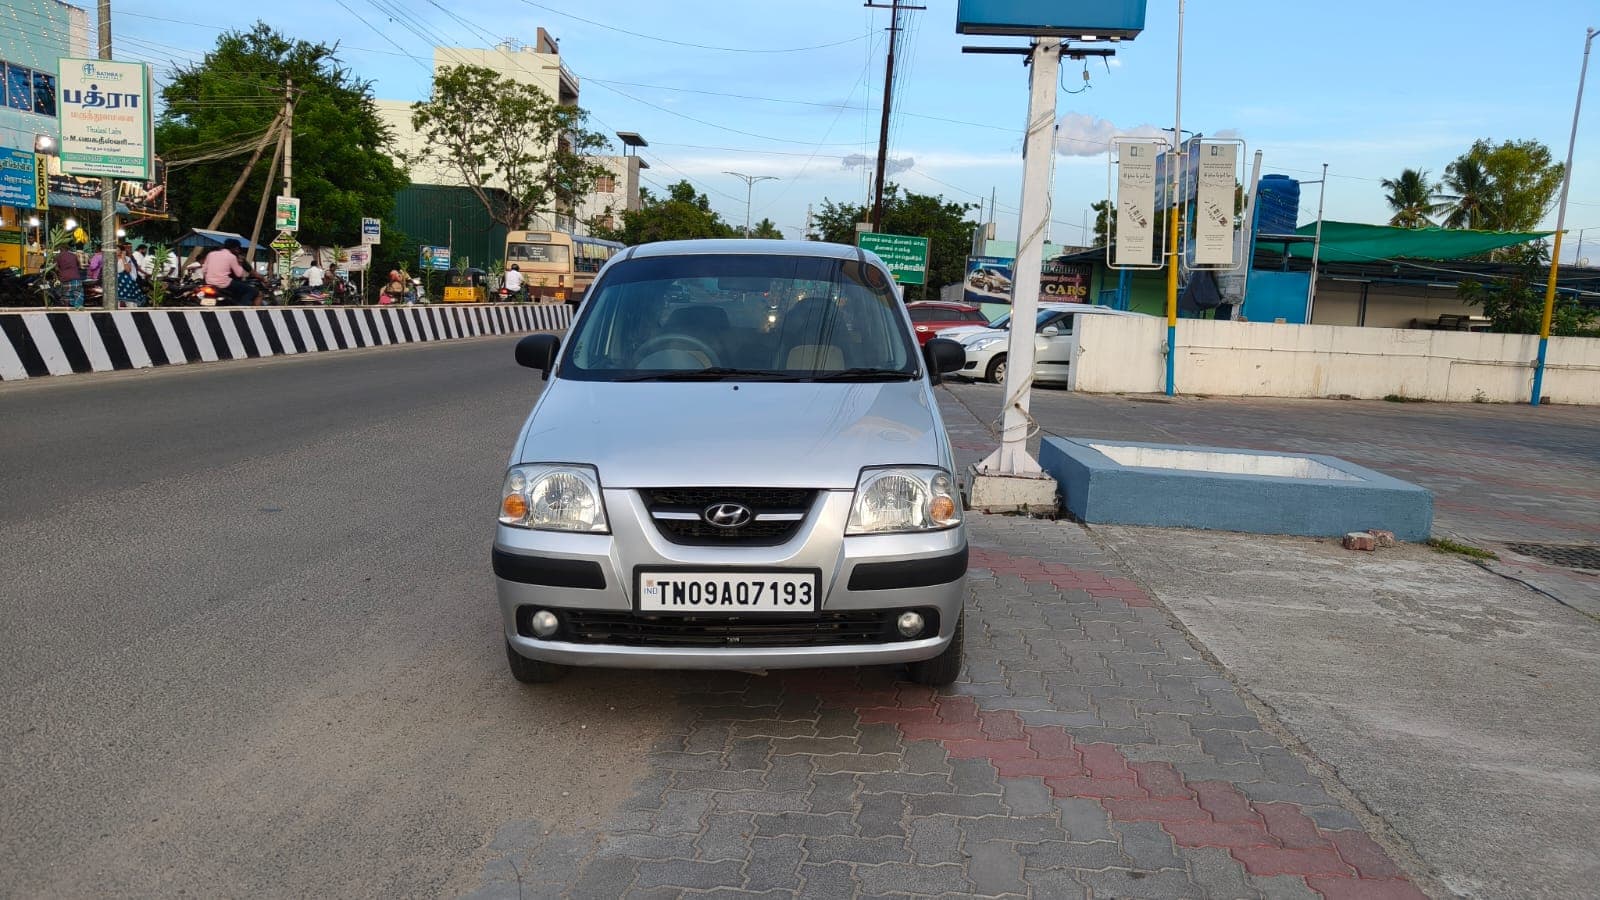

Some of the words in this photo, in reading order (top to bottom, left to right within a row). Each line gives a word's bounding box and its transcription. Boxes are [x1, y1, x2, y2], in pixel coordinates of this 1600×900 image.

[63, 83, 141, 109] பத்ரா
[37, 157, 46, 207] XEROX
[1045, 284, 1087, 296] CARS
[644, 587, 657, 595] IND
[657, 581, 812, 606] TN09AQ7193
